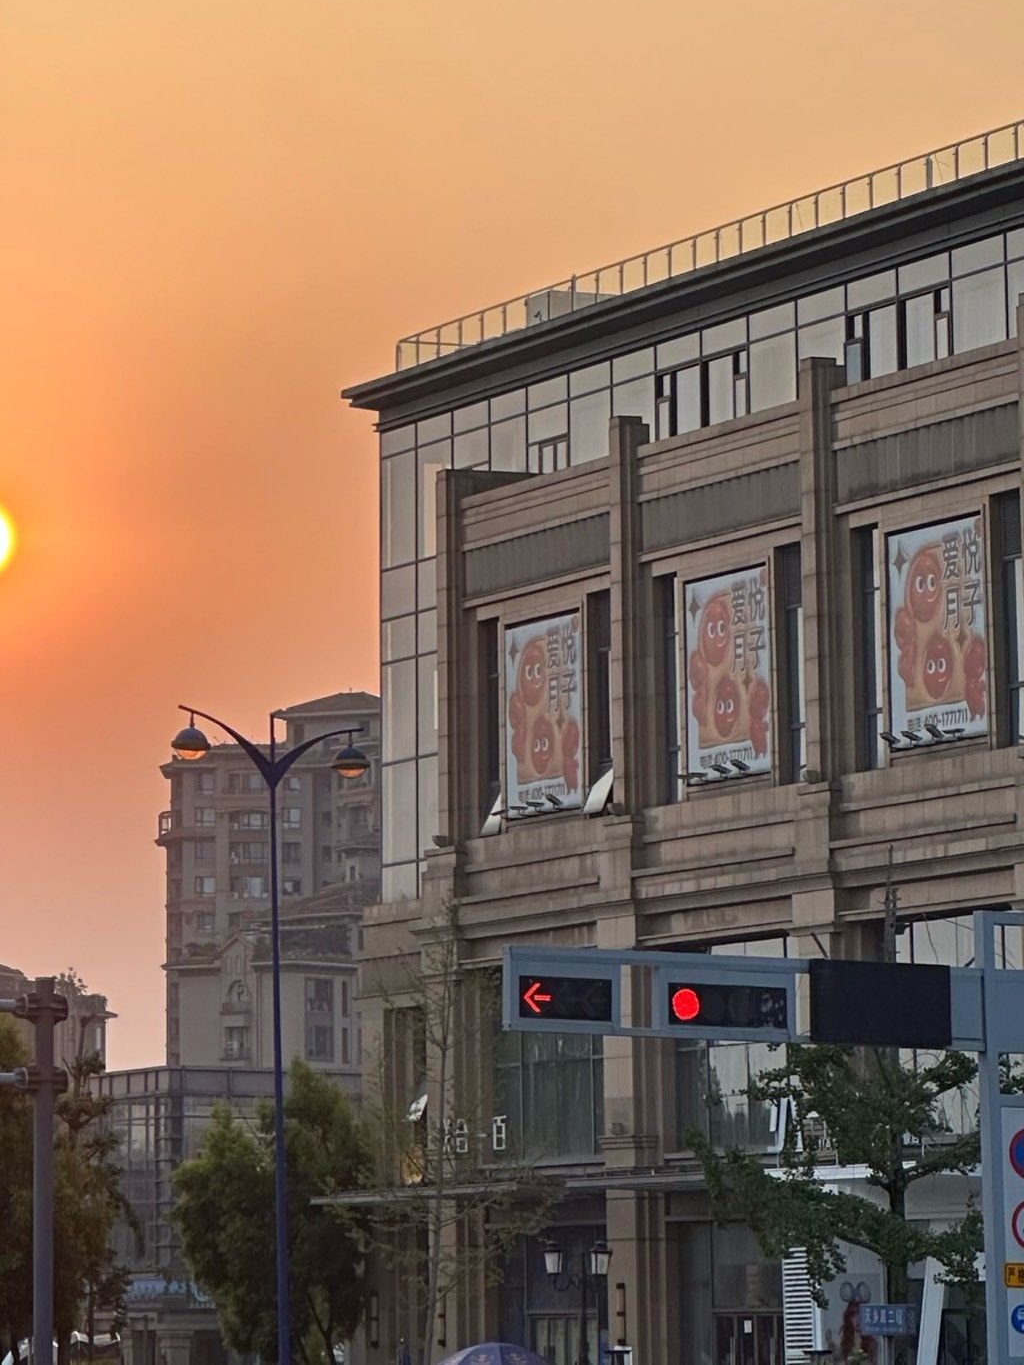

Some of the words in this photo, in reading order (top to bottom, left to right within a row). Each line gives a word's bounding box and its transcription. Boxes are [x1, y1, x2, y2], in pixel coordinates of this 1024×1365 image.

[943, 527, 981, 580] 爱悦
[731, 578, 766, 626] 爱悦
[943, 580, 982, 631] 月子
[732, 626, 766, 673] 月子
[547, 671, 576, 713] 月子
